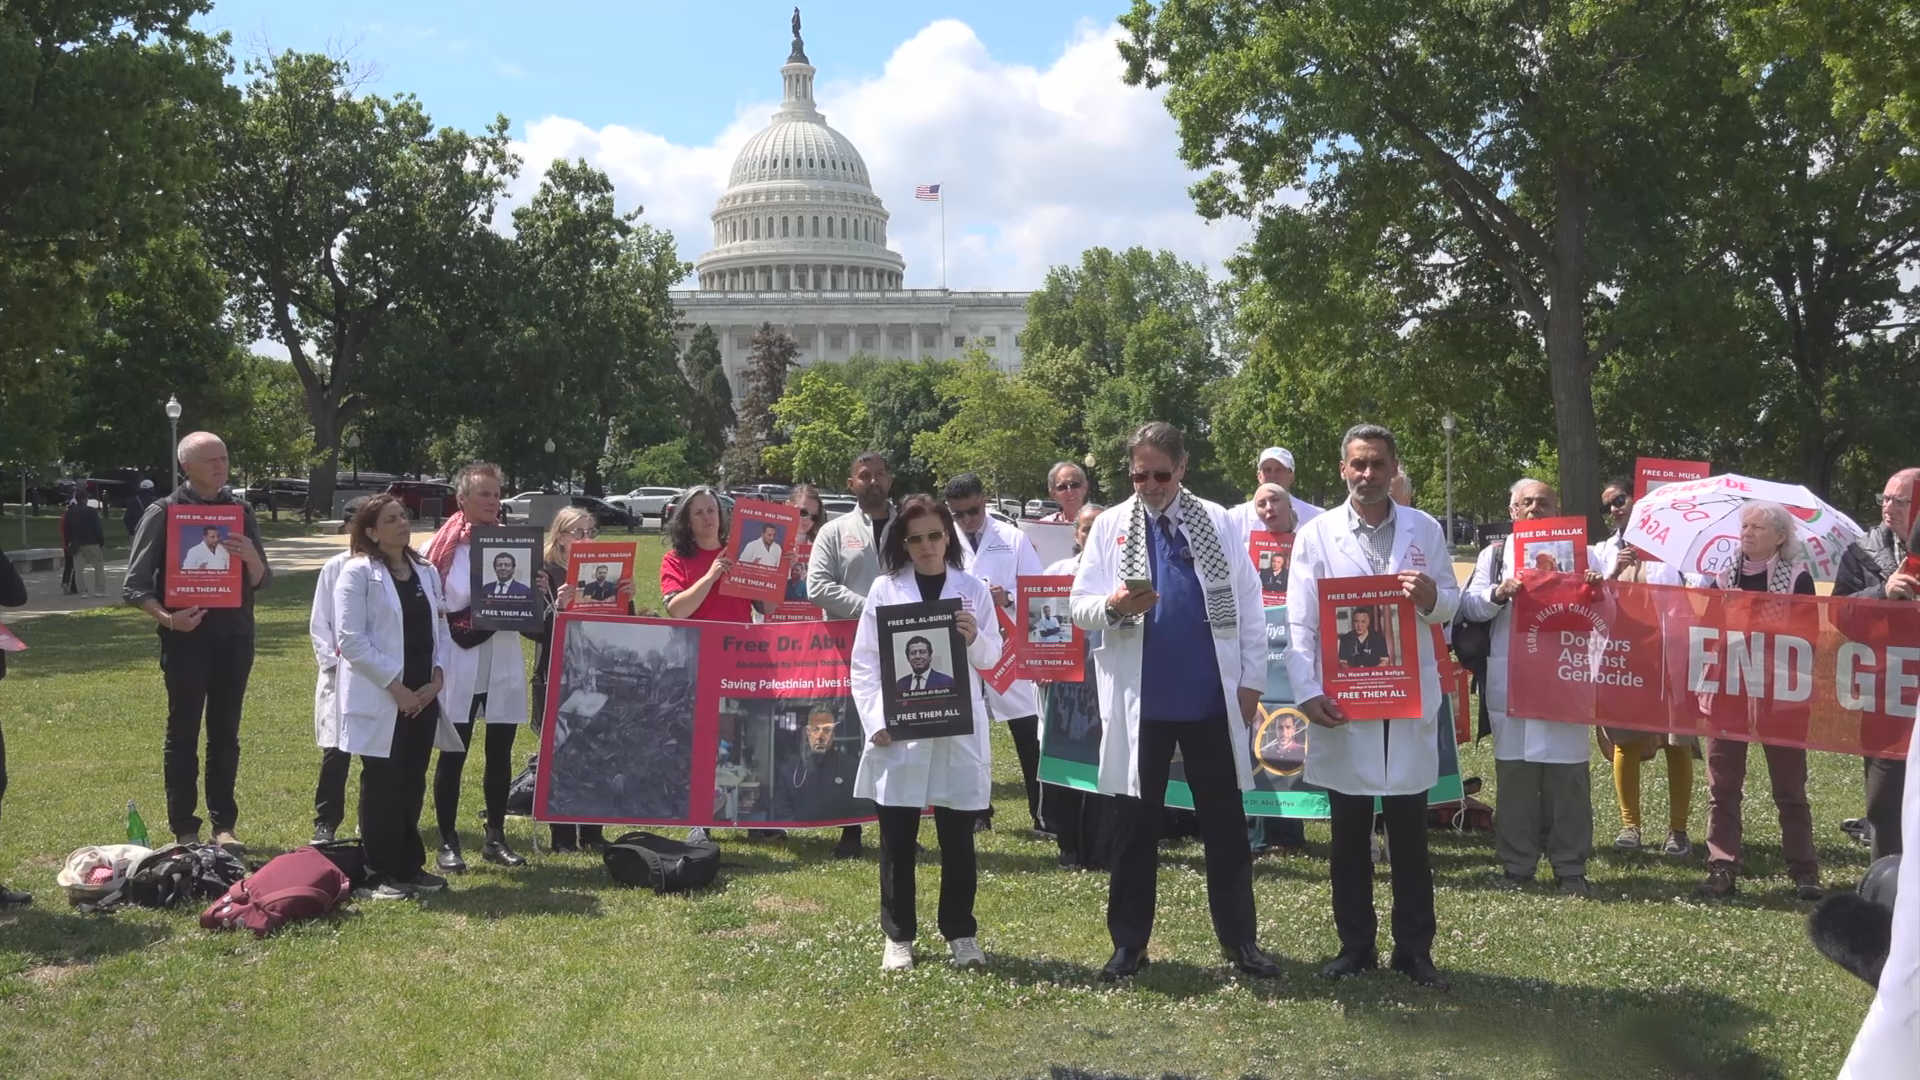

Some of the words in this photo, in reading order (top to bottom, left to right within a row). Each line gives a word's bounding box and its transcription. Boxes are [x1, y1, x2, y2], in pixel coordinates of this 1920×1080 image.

[1642, 469, 1661, 477] FREE
[1663, 470, 1676, 478] DR.
[1678, 471, 1701, 479] MUSA
[1516, 531, 1534, 539] FREE
[1551, 528, 1583, 536] HALLAK
[730, 576, 746, 584] FREE
[747, 578, 765, 587] THEM
[765, 582, 778, 590] ALL
[1057, 585, 1073, 593] MUS
[1327, 593, 1345, 601] FREE
[887, 619, 905, 627] FREE
[918, 614, 952, 624] AL-BURSH
[1266, 623, 1285, 640] fiya
[1526, 624, 1540, 654] GLOBAL
[1535, 603, 1564, 622] HEALTH
[1568, 602, 1607, 631] COALITION
[723, 635, 770, 653] Free
[777, 635, 802, 652] Dr.
[810, 634, 846, 651] Abu
[1560, 630, 1631, 652] Doctors
[1688, 626, 1813, 702] END
[993, 666, 1006, 680] FREE
[1558, 665, 1644, 687] Genocide
[720, 678, 757, 691] Saving
[759, 678, 814, 690] Palestinian
[817, 677, 841, 688] Lives
[843, 677, 852, 687] is
[1337, 691, 1360, 699] FREE
[1361, 690, 1389, 698] THEM
[1389, 689, 1408, 698] ALL
[896, 713, 918, 722] FREE
[919, 710, 943, 720] THEM
[944, 708, 960, 717] ALL
